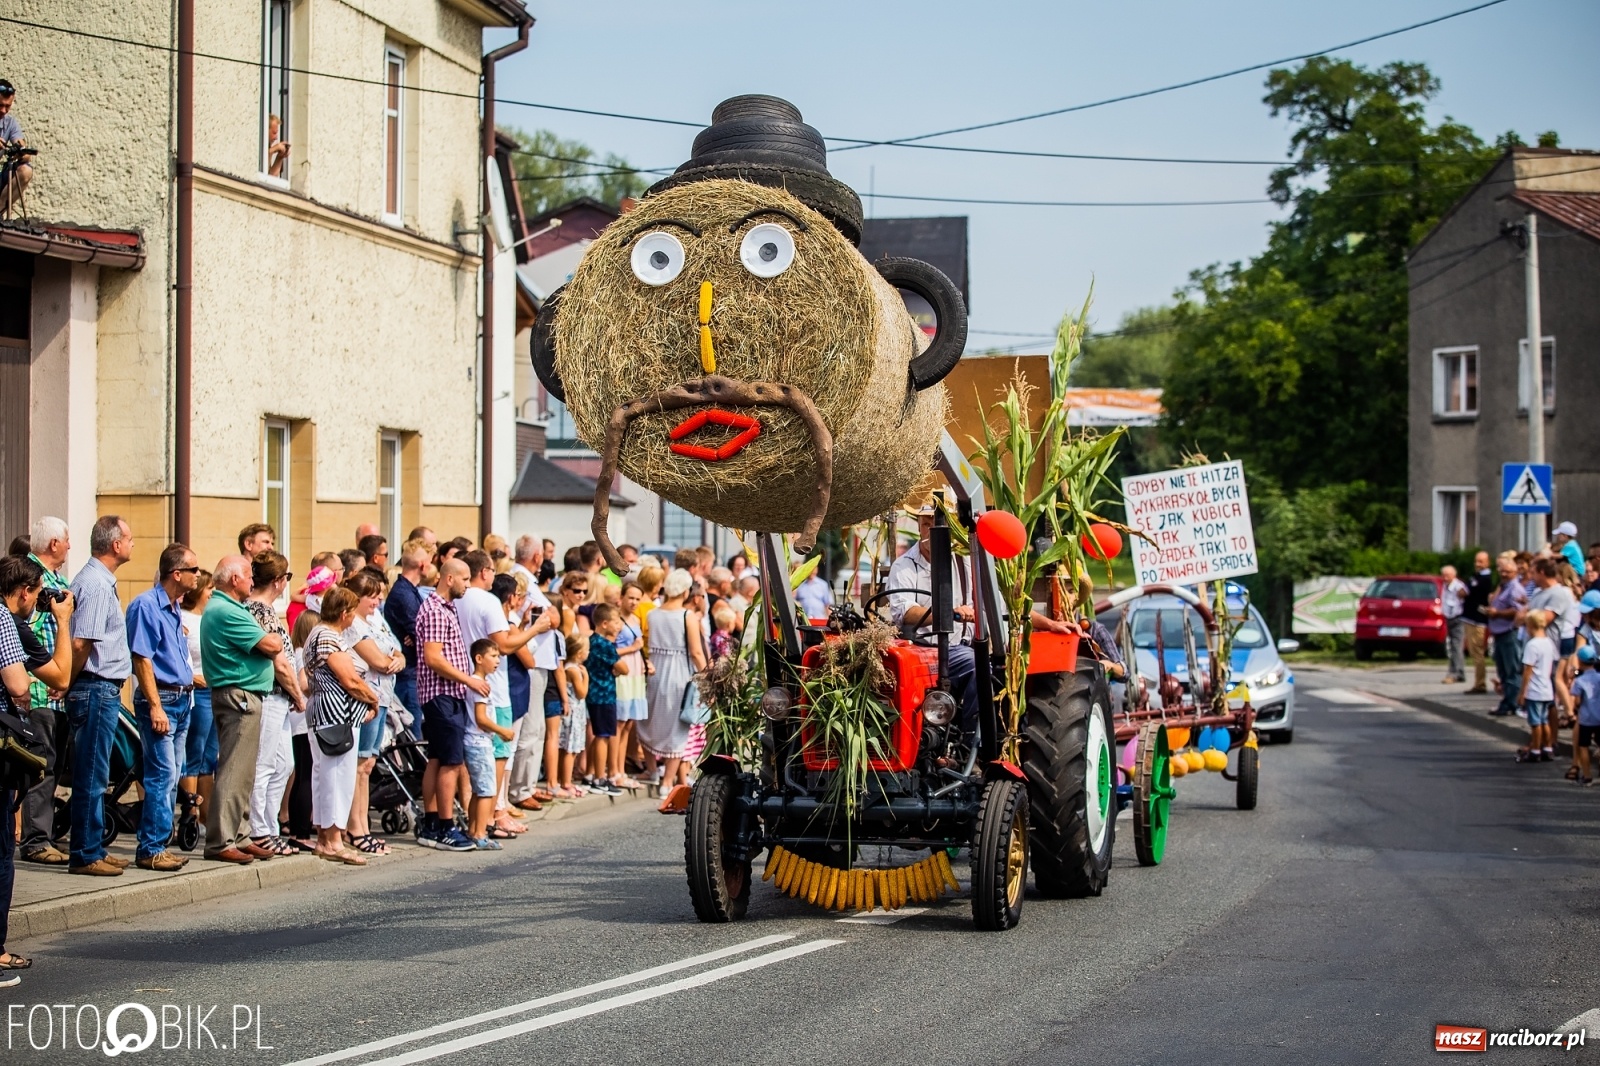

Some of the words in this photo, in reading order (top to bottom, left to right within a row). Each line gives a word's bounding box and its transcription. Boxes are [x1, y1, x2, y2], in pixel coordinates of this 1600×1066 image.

[1128, 478, 1166, 496] GDYBY
[1212, 485, 1240, 502] BYCH
[1137, 516, 1153, 532] SE
[1159, 512, 1185, 530] JAK
[1192, 503, 1241, 523] KUBICA
[1153, 530, 1179, 550] TAK
[1194, 523, 1227, 539] MOM
[1200, 542, 1227, 559] TAKI
[1231, 536, 1247, 551] TO
[1212, 553, 1253, 572] SPADEK
